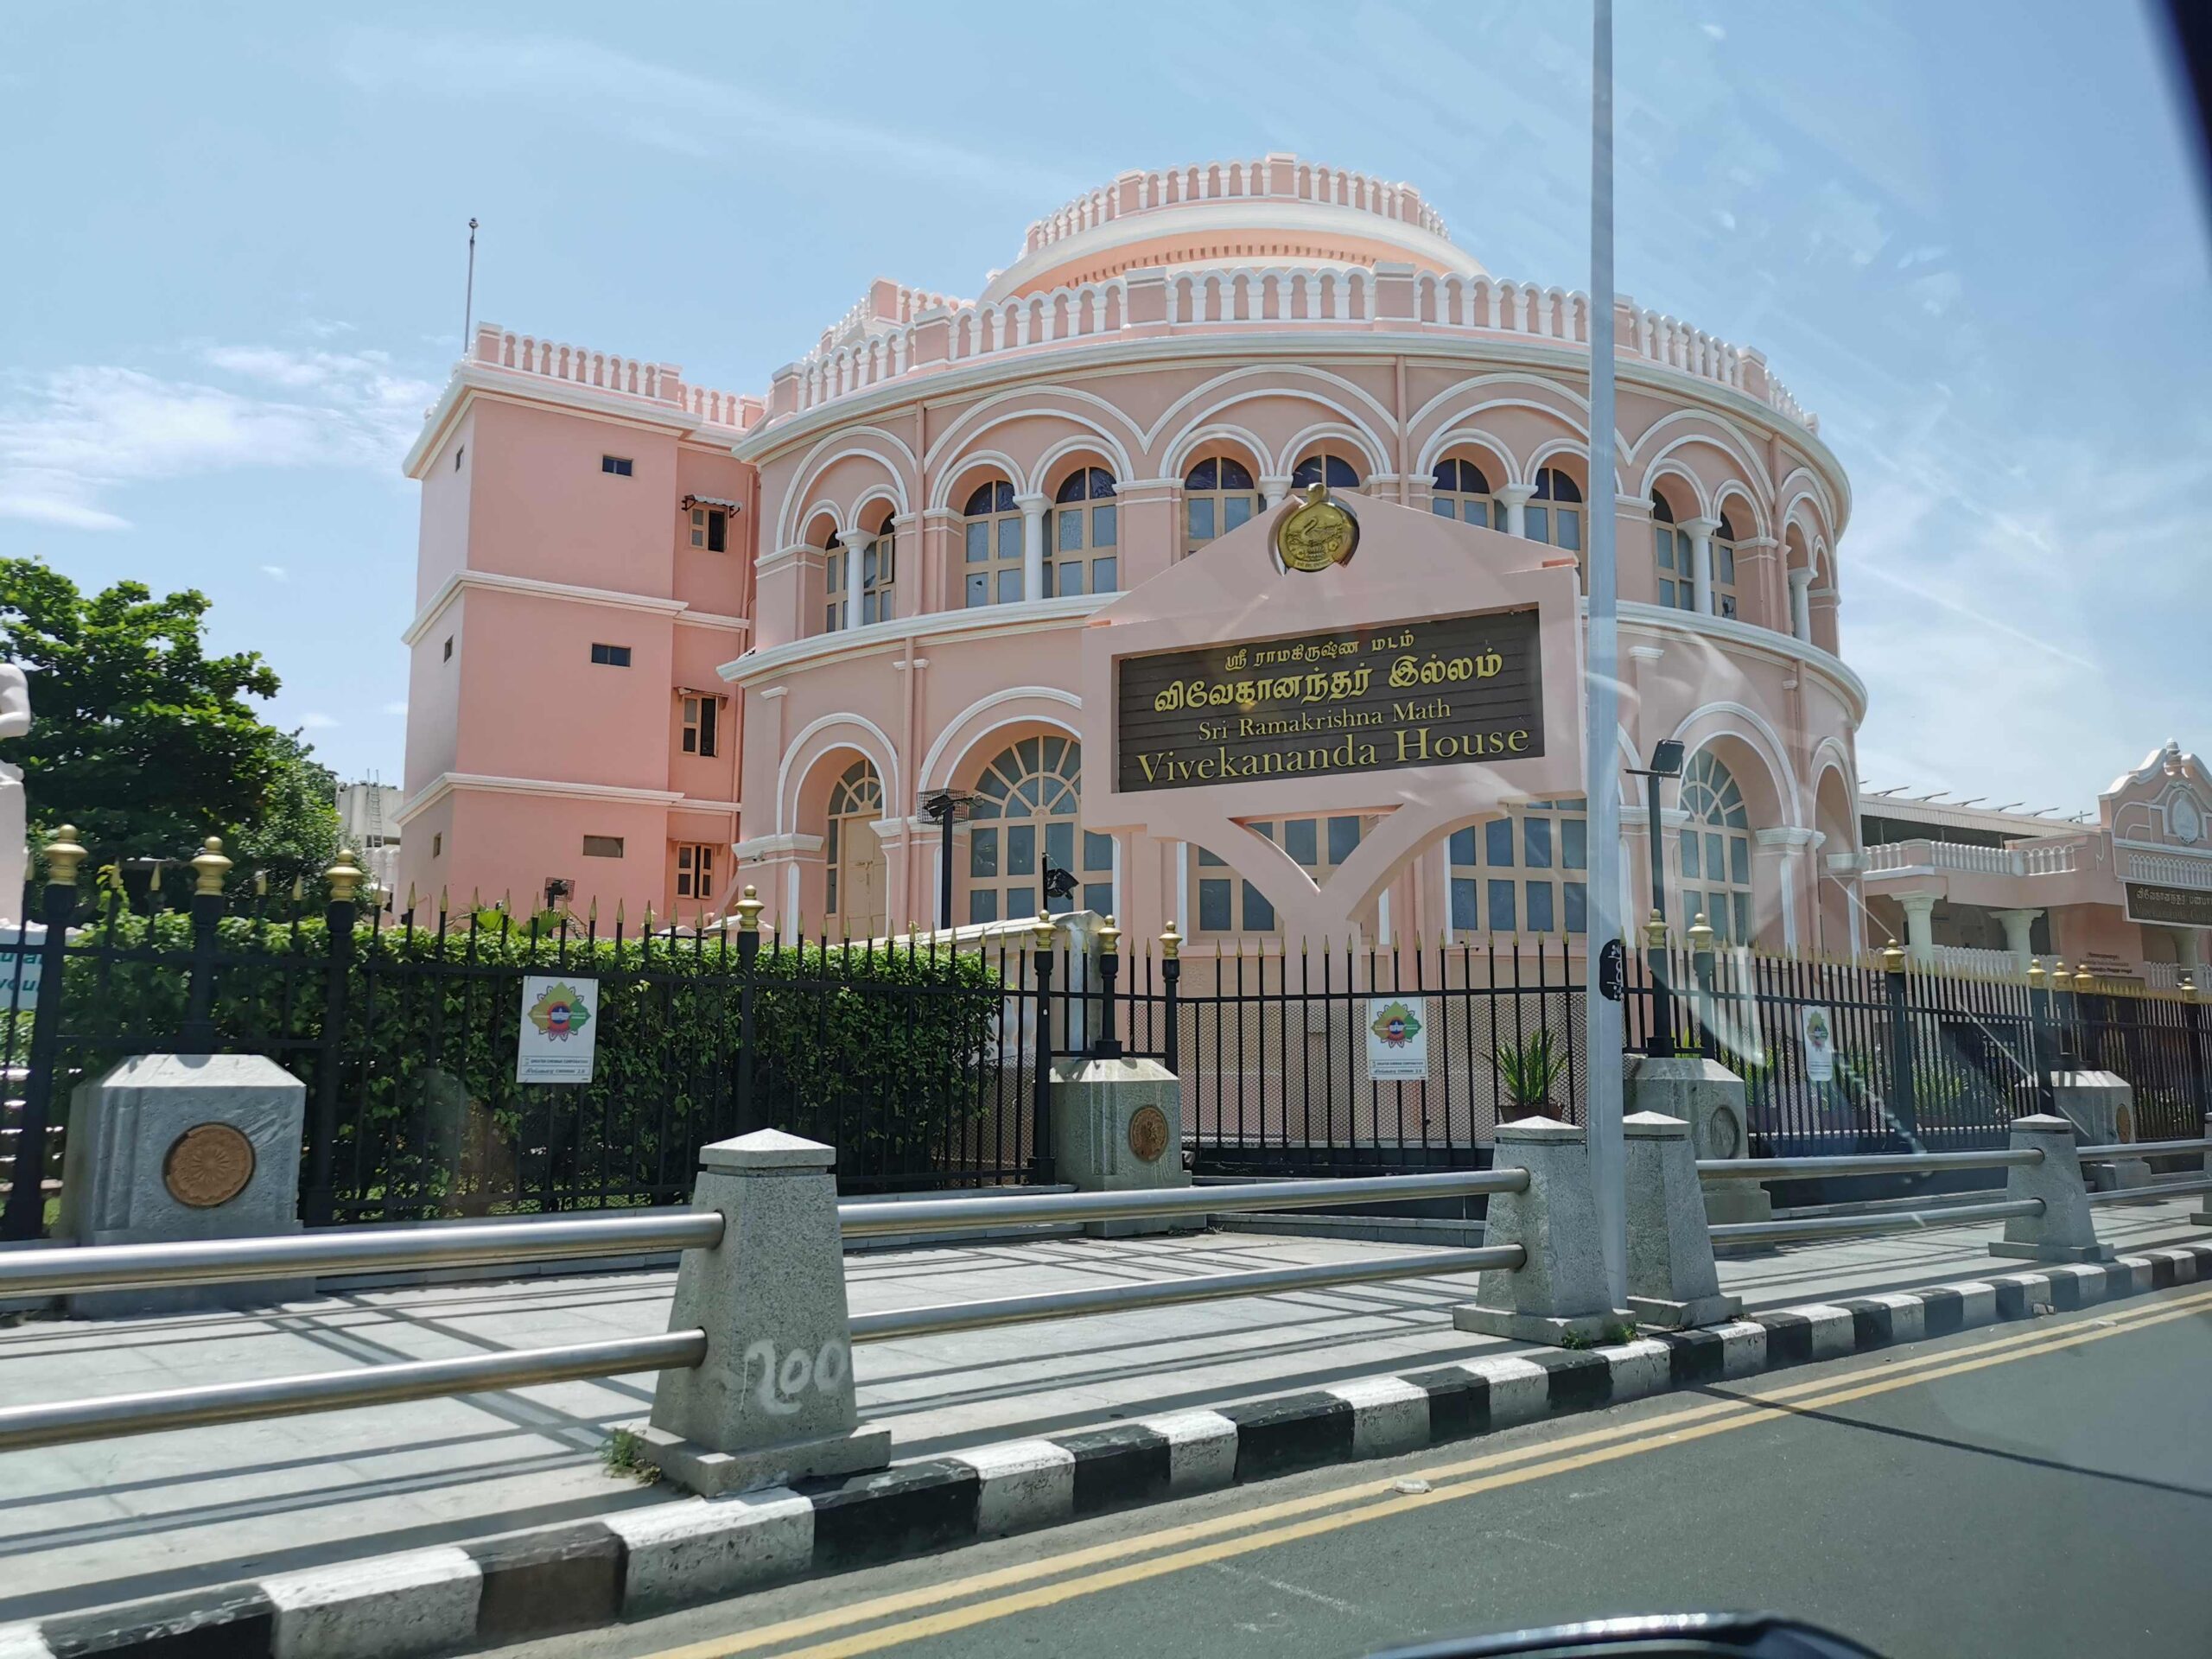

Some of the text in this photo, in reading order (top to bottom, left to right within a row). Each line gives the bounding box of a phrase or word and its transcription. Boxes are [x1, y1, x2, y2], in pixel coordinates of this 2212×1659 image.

[1225, 629, 1414, 671] ஸ்ரீ ராமகிருஷ்ண மடம்
[1154, 647, 1503, 712] விவேகானந்தர் இல்லம்
[1198, 698, 1452, 741] Sri Ramakrishna Math
[1136, 728, 1529, 784] Vivekananda House
